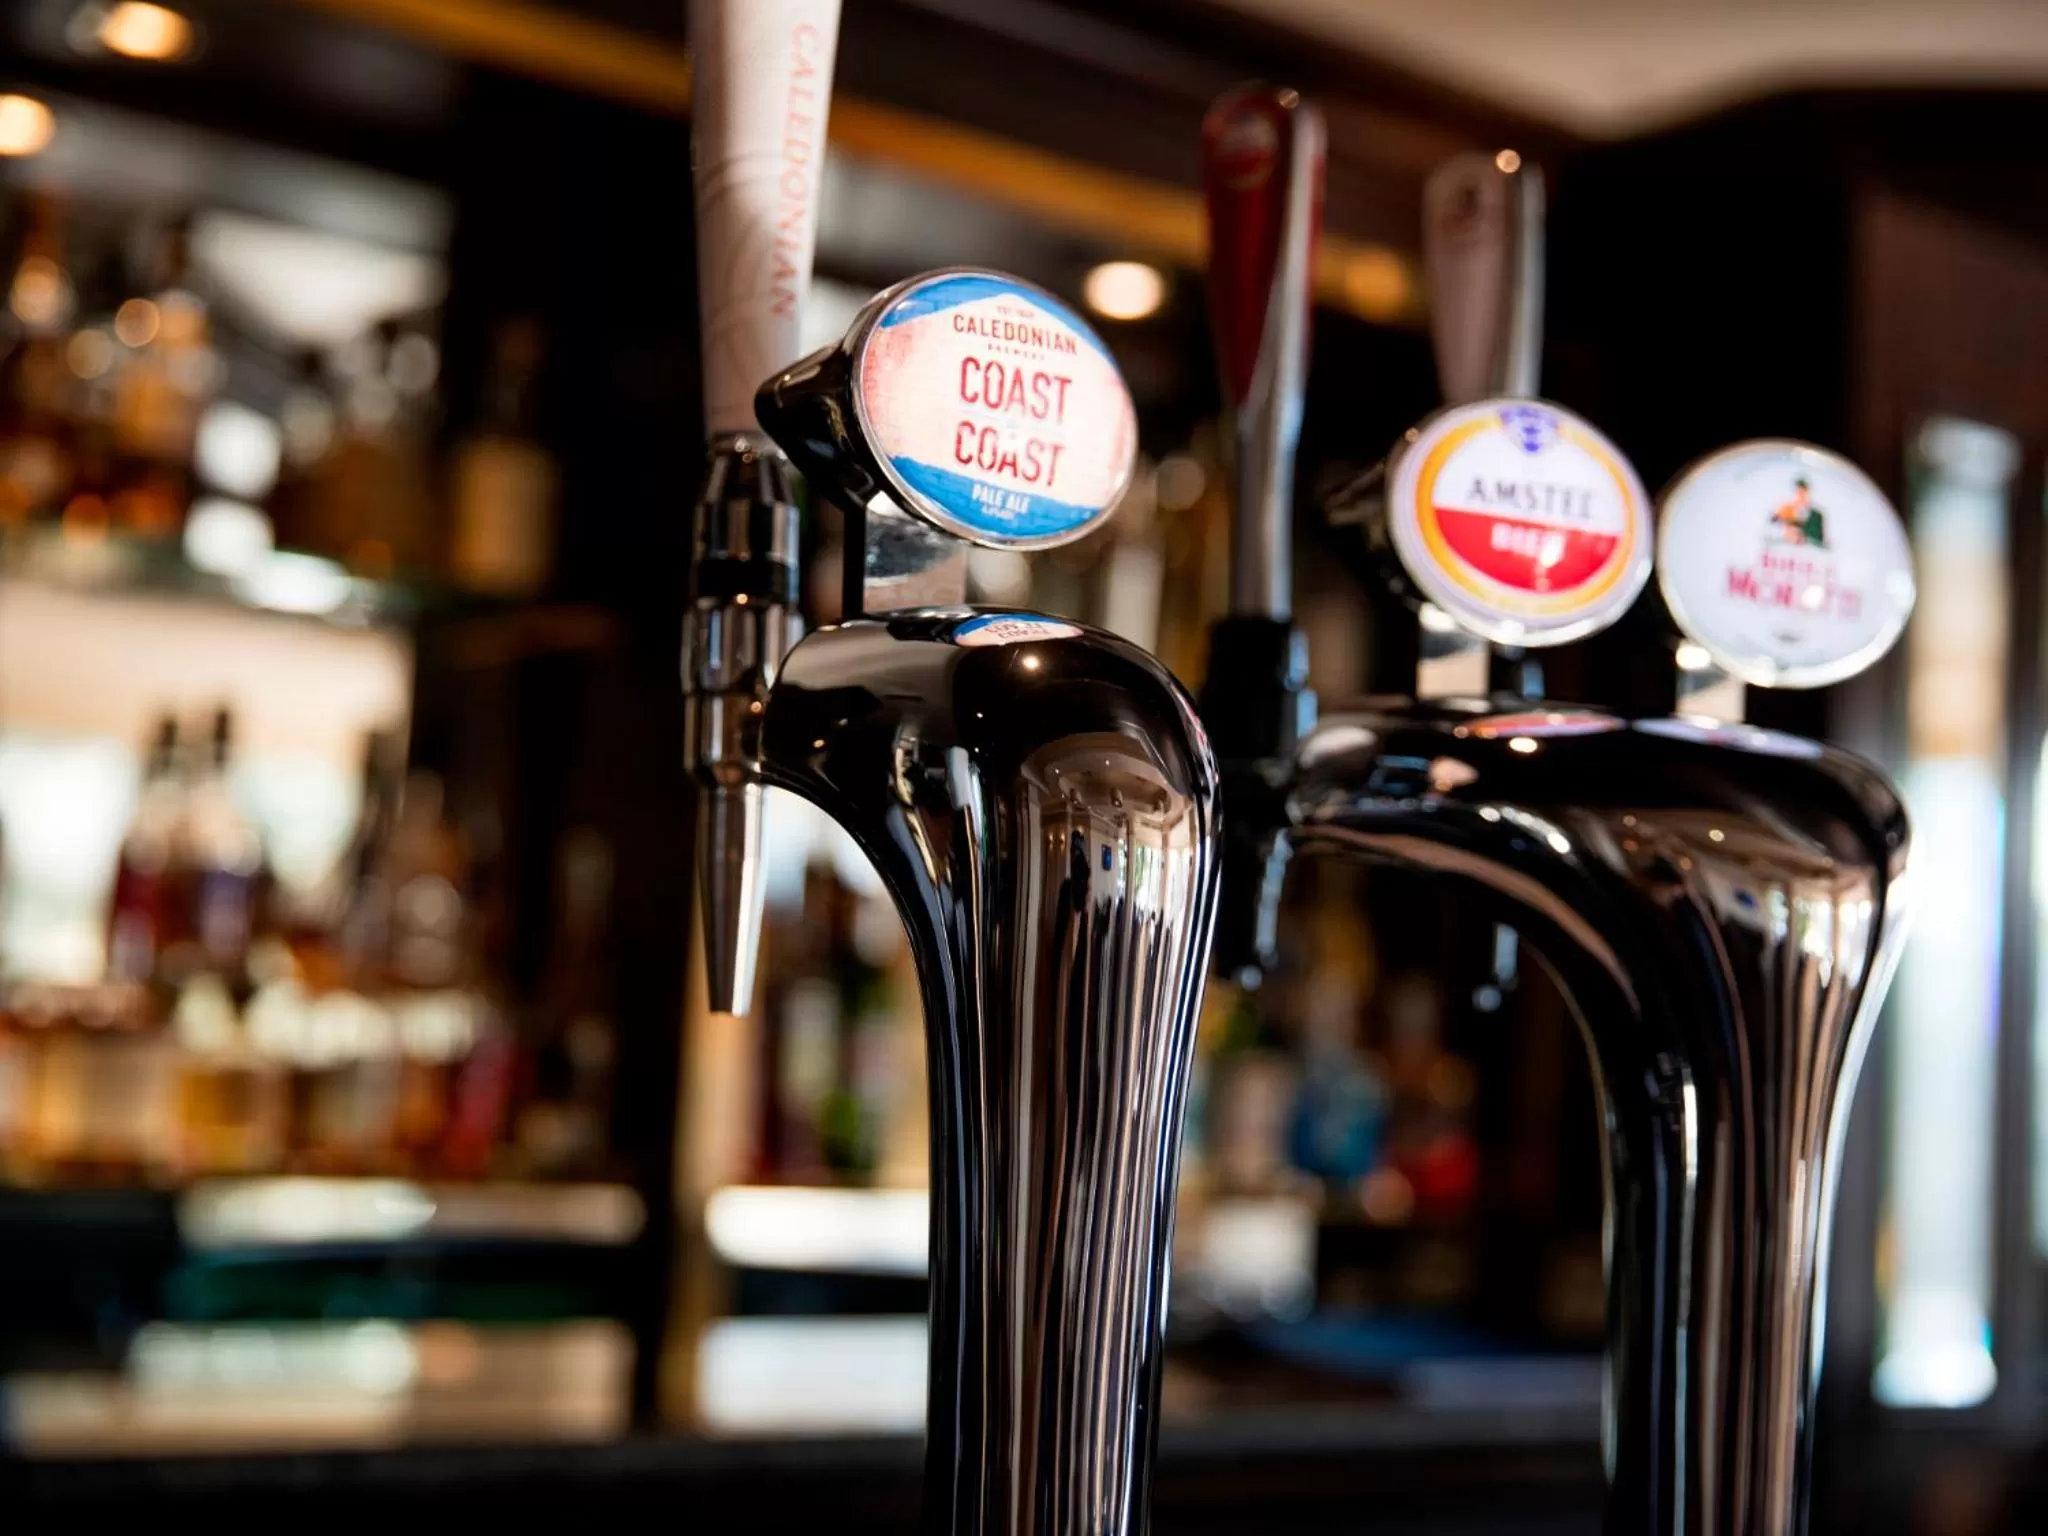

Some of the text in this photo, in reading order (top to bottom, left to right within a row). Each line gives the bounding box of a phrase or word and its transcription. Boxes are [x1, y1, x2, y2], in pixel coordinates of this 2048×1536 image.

[769, 22, 820, 322] CALEDONIAN
[953, 314, 1078, 355] CALEDONIAN
[959, 355, 1073, 426] COAST
[953, 419, 1066, 488] COAST
[971, 483, 1004, 509] PALE
[1006, 491, 1031, 515] ALE
